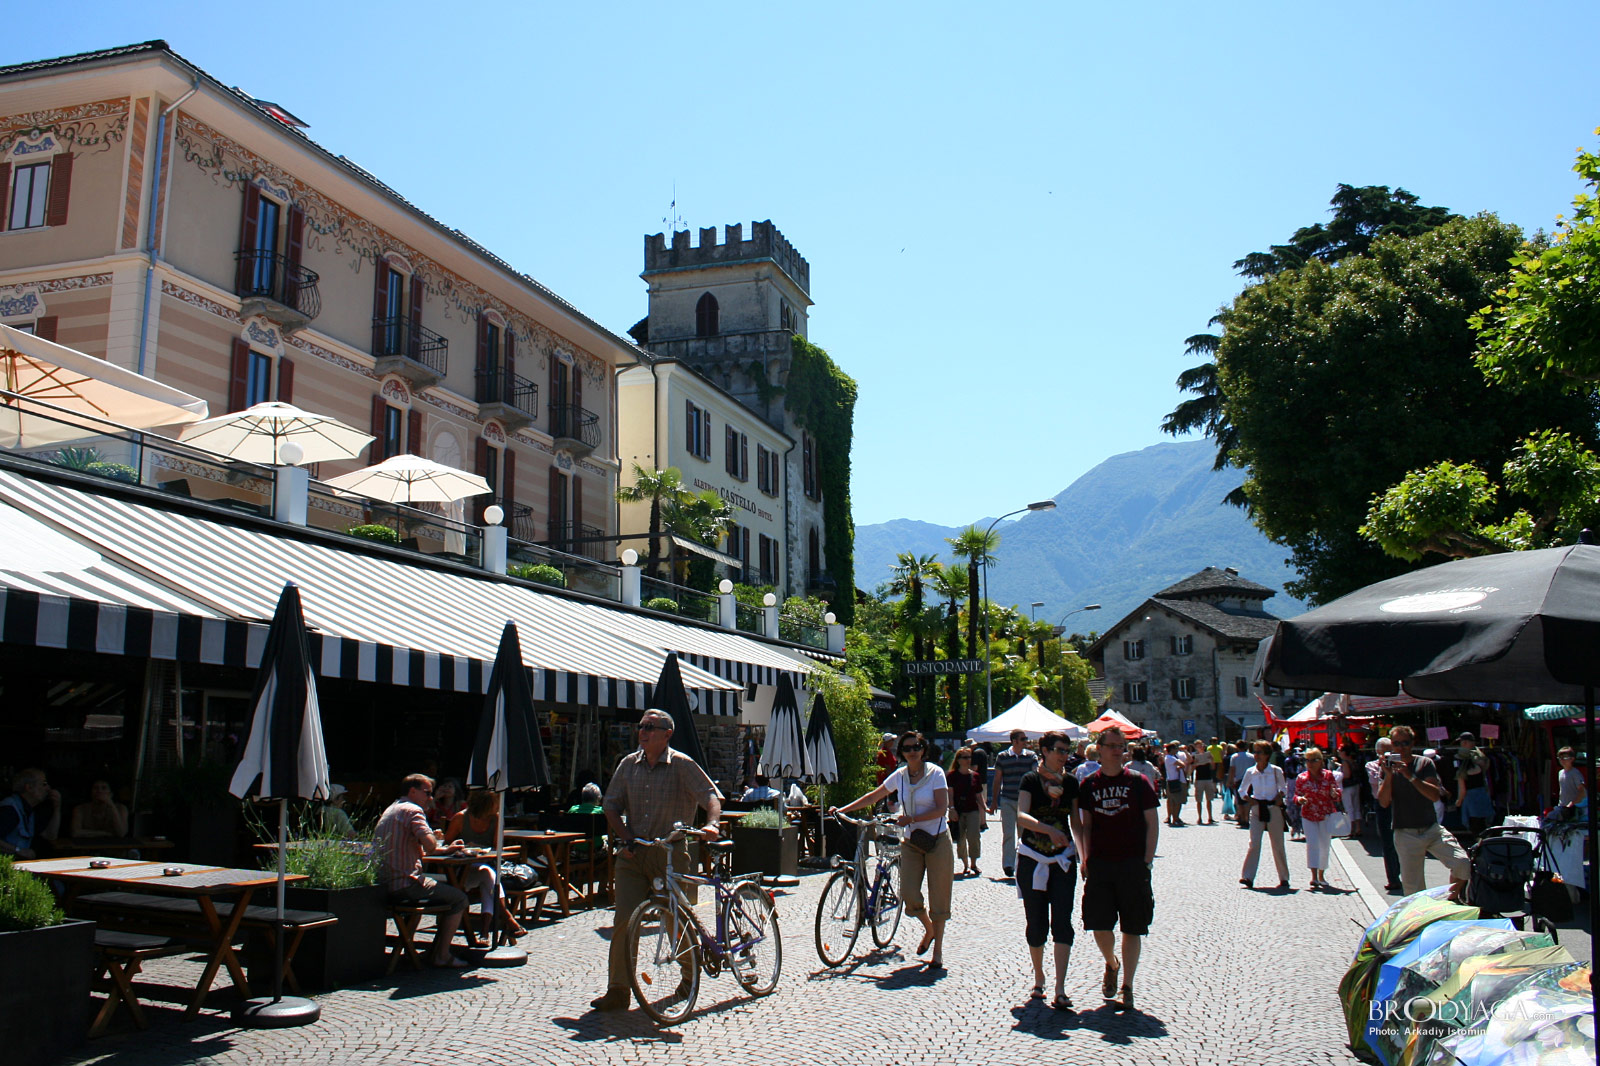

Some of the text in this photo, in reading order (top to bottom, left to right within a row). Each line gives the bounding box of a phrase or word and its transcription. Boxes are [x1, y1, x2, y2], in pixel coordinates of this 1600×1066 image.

[720, 487, 756, 514] CASTELLO
[758, 508, 773, 522] HOTEL
[906, 660, 981, 674] RISTORANTE
[1092, 786, 1130, 802] WAYNE
